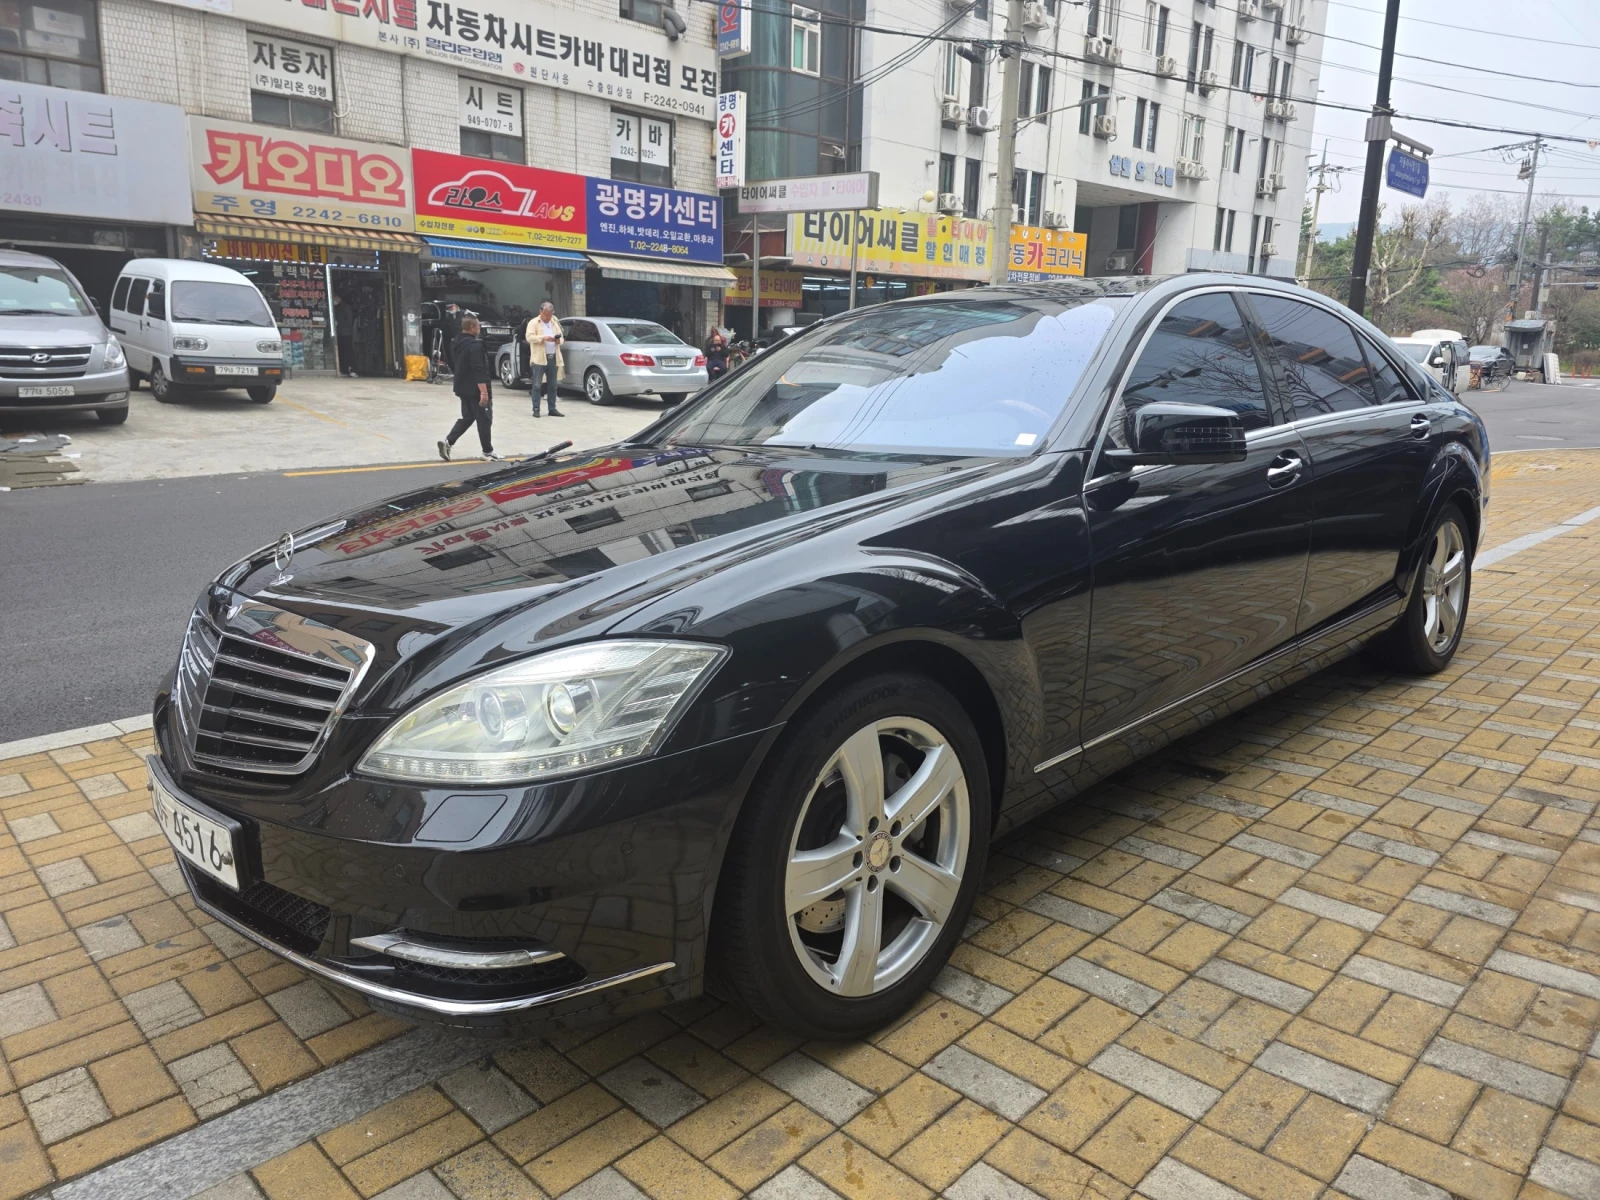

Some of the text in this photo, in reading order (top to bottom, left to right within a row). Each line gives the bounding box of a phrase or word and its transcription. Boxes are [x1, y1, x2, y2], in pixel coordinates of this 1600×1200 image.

[253, 41, 328, 80] 자동차
[425, 48, 449, 60] MILLION
[463, 57, 503, 71] CORPORATION
[680, 65, 717, 98] 모집
[643, 92, 706, 116] F:2242-0941
[205, 131, 404, 206] 카오디오
[596, 183, 718, 230] 광명카센터
[741, 185, 787, 201] 타이어써클
[292, 206, 403, 228] 2242-6810
[803, 212, 919, 253] 타이어써클
[173, 808, 223, 872] 4516
